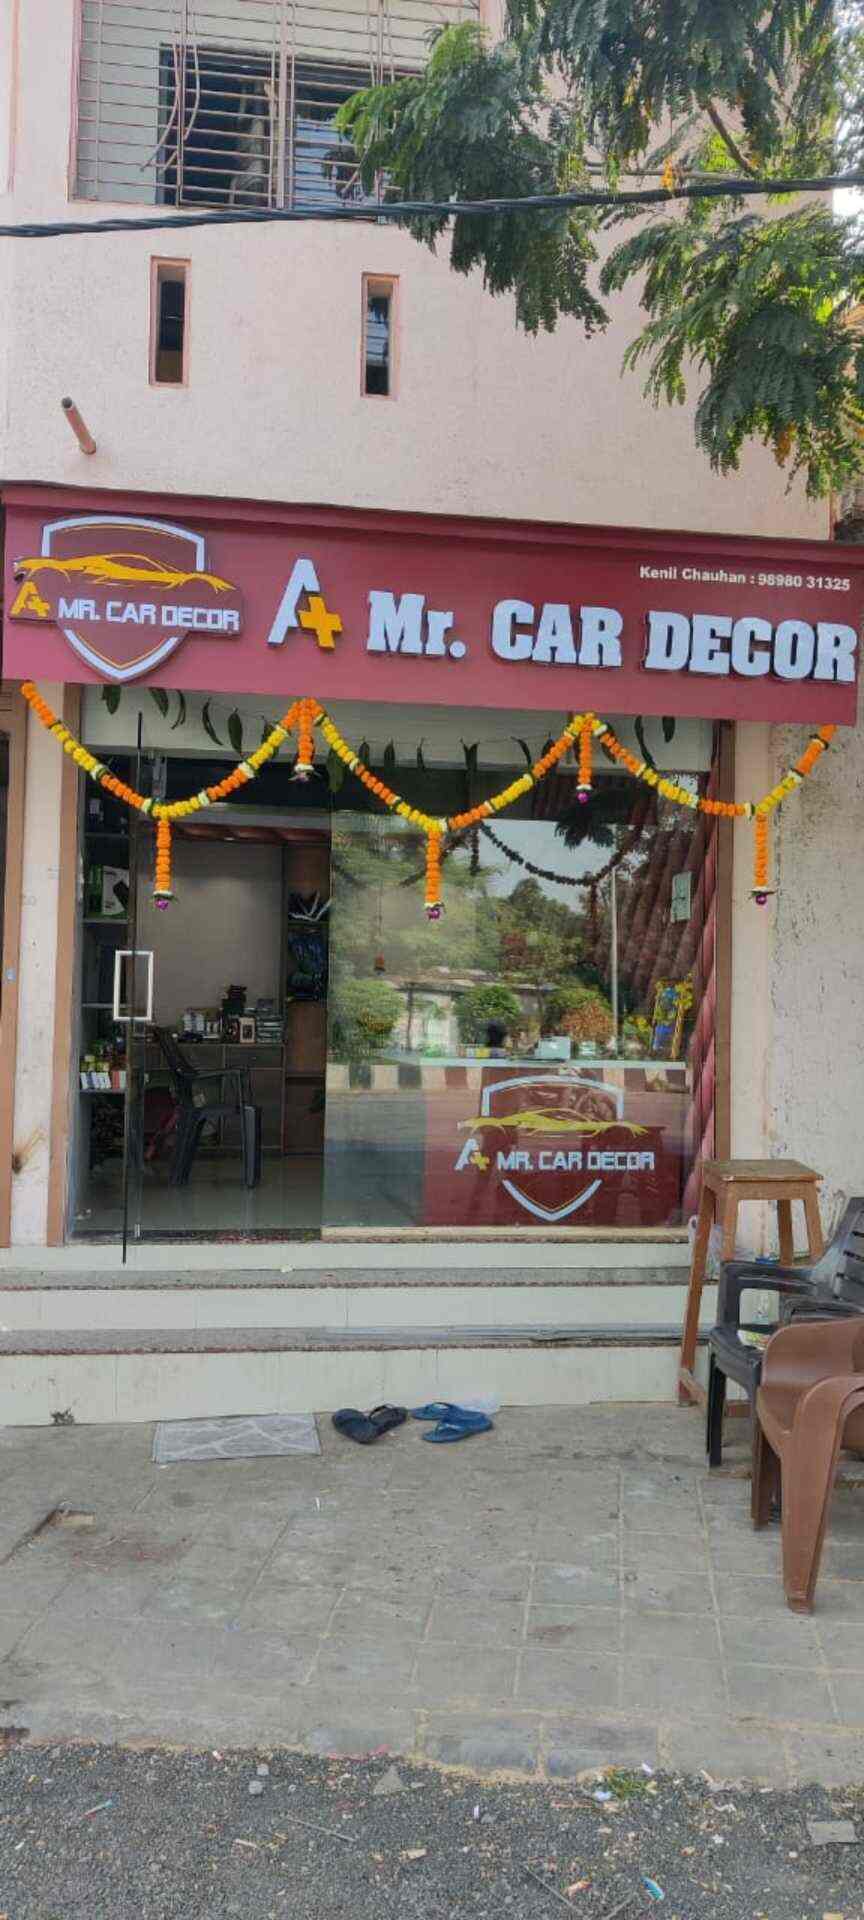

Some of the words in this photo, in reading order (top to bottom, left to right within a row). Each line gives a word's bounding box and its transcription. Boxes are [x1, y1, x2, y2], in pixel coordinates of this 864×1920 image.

[639, 566, 677, 580] Kenil
[682, 568, 746, 584] Chauhan
[758, 573, 802, 588] 98980
[806, 575, 850, 591] 31325
[58, 598, 100, 621] MR.
[105, 600, 156, 625] CAR
[161, 605, 240, 631] DECOR
[268, 559, 343, 649] A+
[367, 590, 466, 658] Mr.
[491, 599, 624, 667] CAR
[644, 610, 857, 682] DECOR
[497, 1151, 533, 1170] MR.
[538, 1151, 582, 1170] CAR
[587, 1152, 655, 1170] DECOR
